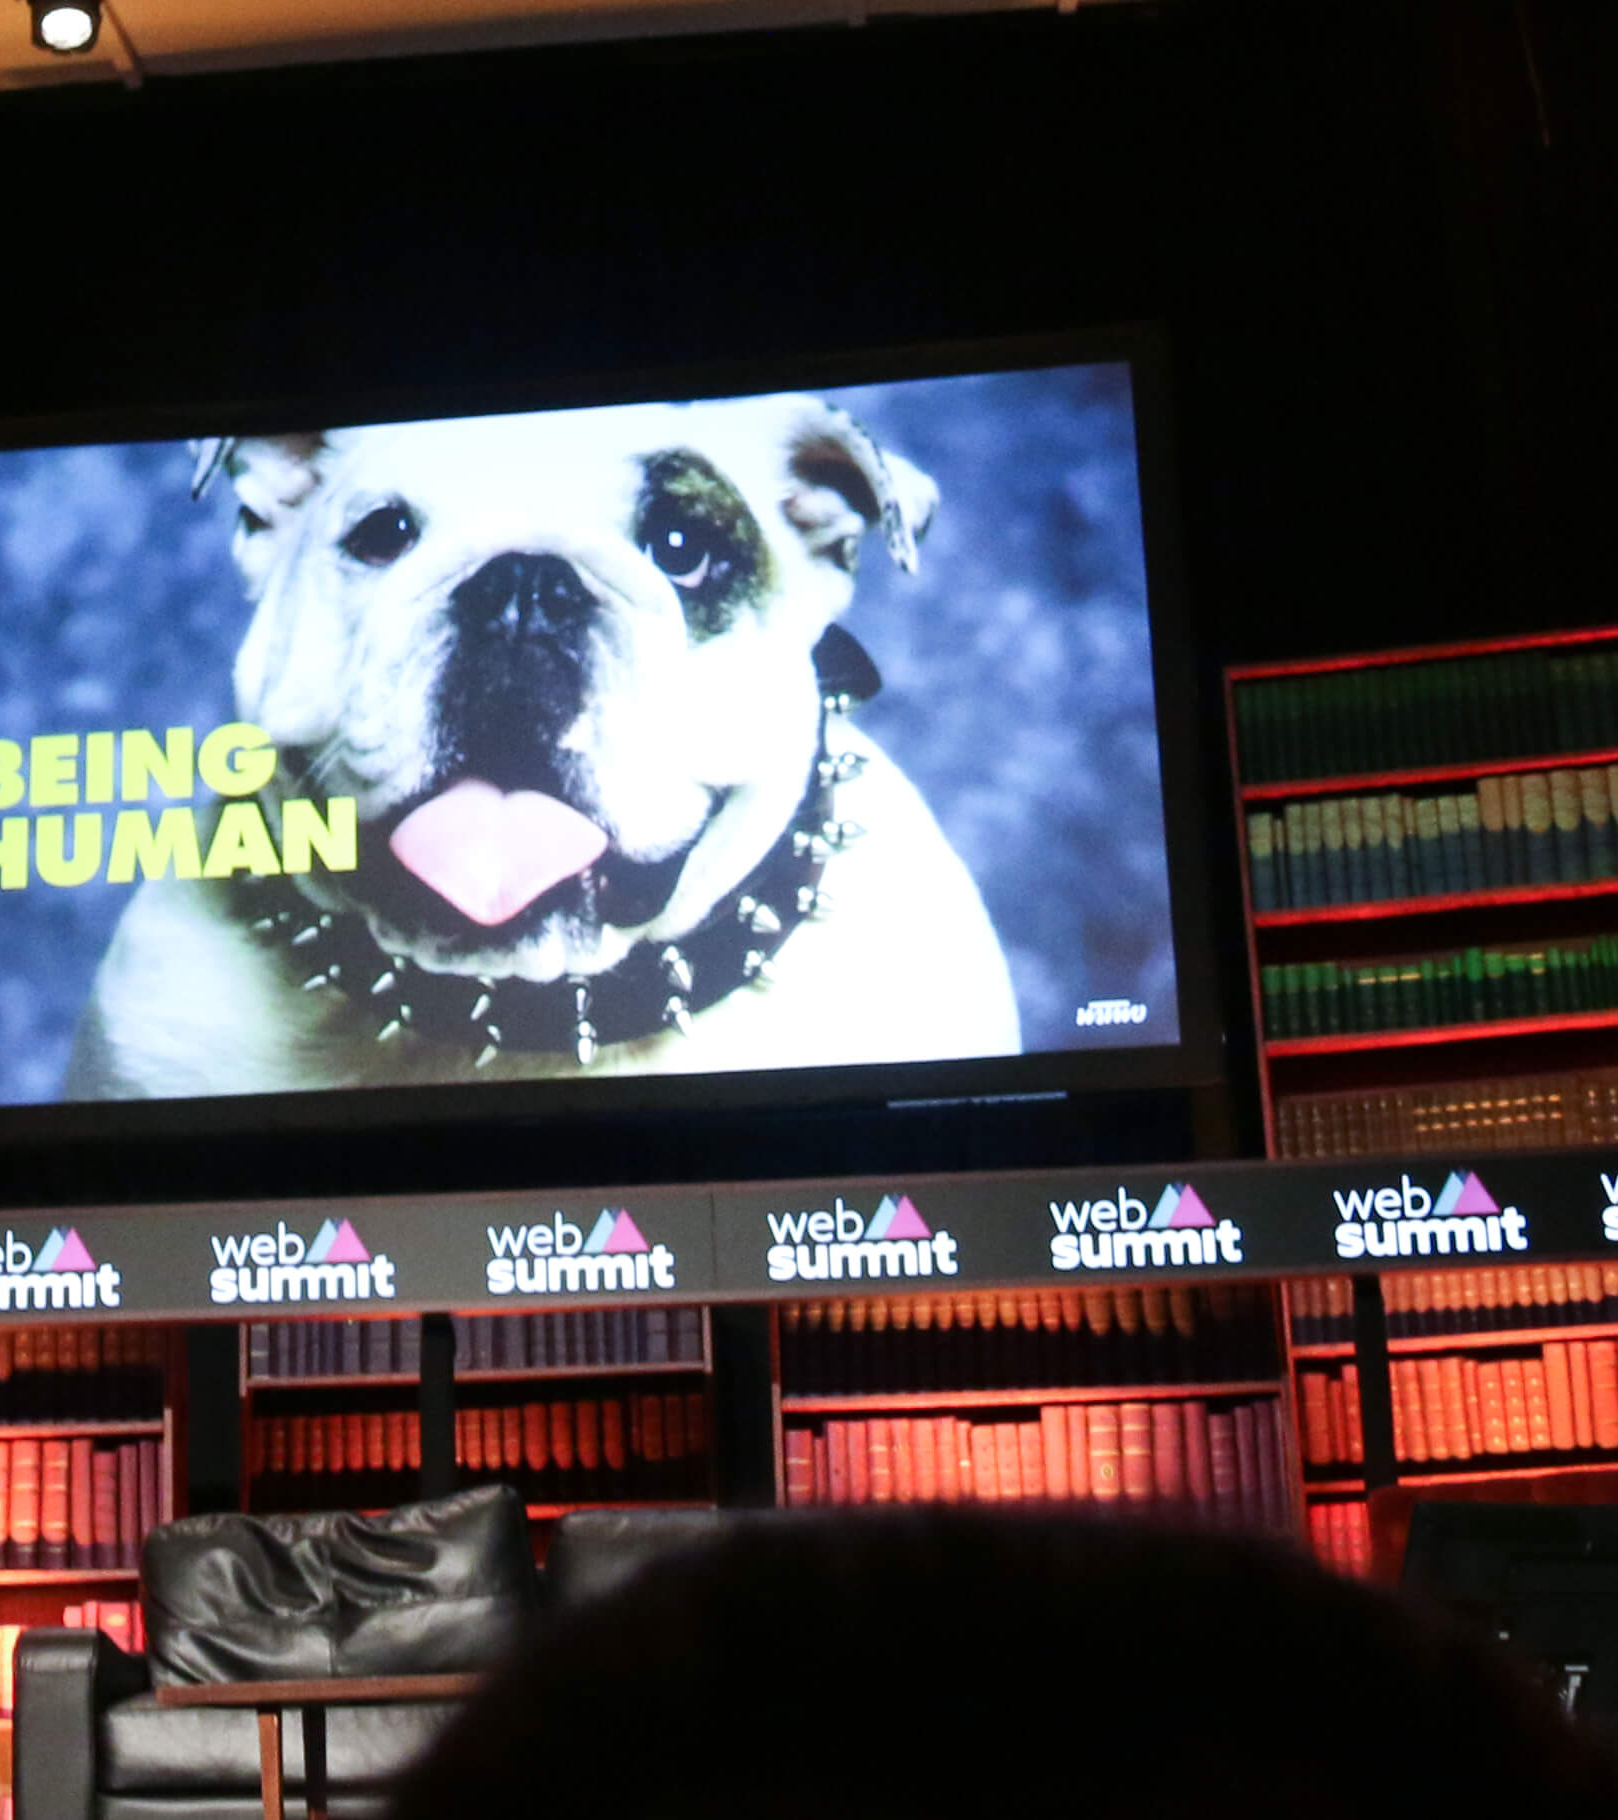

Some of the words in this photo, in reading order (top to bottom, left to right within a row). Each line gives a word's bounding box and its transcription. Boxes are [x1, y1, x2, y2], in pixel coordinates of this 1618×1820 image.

[767, 1198, 864, 1245] web
[1050, 1187, 1147, 1233] web
[1333, 1175, 1431, 1221] web
[211, 1221, 305, 1267] web
[487, 1211, 582, 1258] web
[767, 1231, 958, 1281] summit
[1050, 1219, 1242, 1269] summit
[1333, 1207, 1528, 1258] summit
[210, 1254, 395, 1303] summit
[486, 1244, 675, 1294] summit
